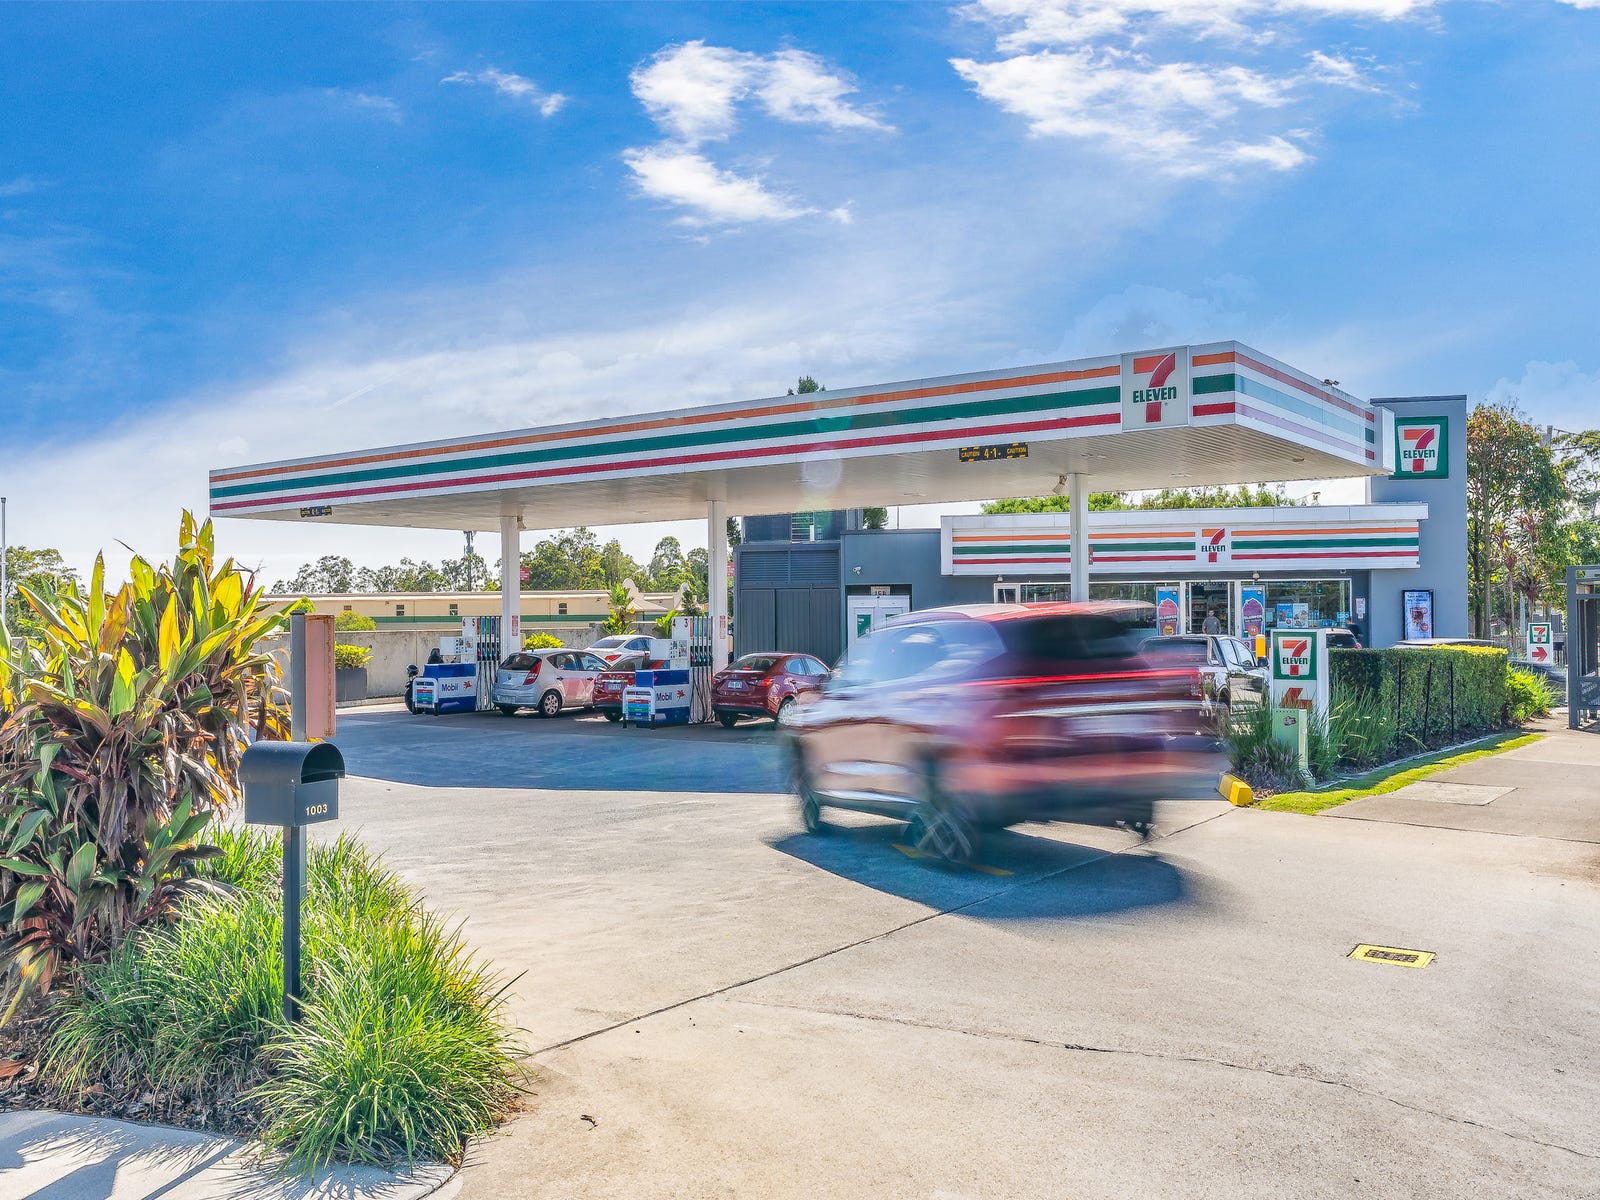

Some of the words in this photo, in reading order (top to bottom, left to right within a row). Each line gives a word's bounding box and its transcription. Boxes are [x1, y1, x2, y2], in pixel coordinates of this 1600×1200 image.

[1133, 352, 1176, 423] 7
[1403, 428, 1435, 472] 7
[1202, 528, 1225, 562] 7
[684, 618, 689, 628] 3
[1282, 640, 1308, 676] 7
[441, 683, 459, 692] Mobil
[656, 691, 673, 701] Mobil
[305, 803, 328, 816] 1003
